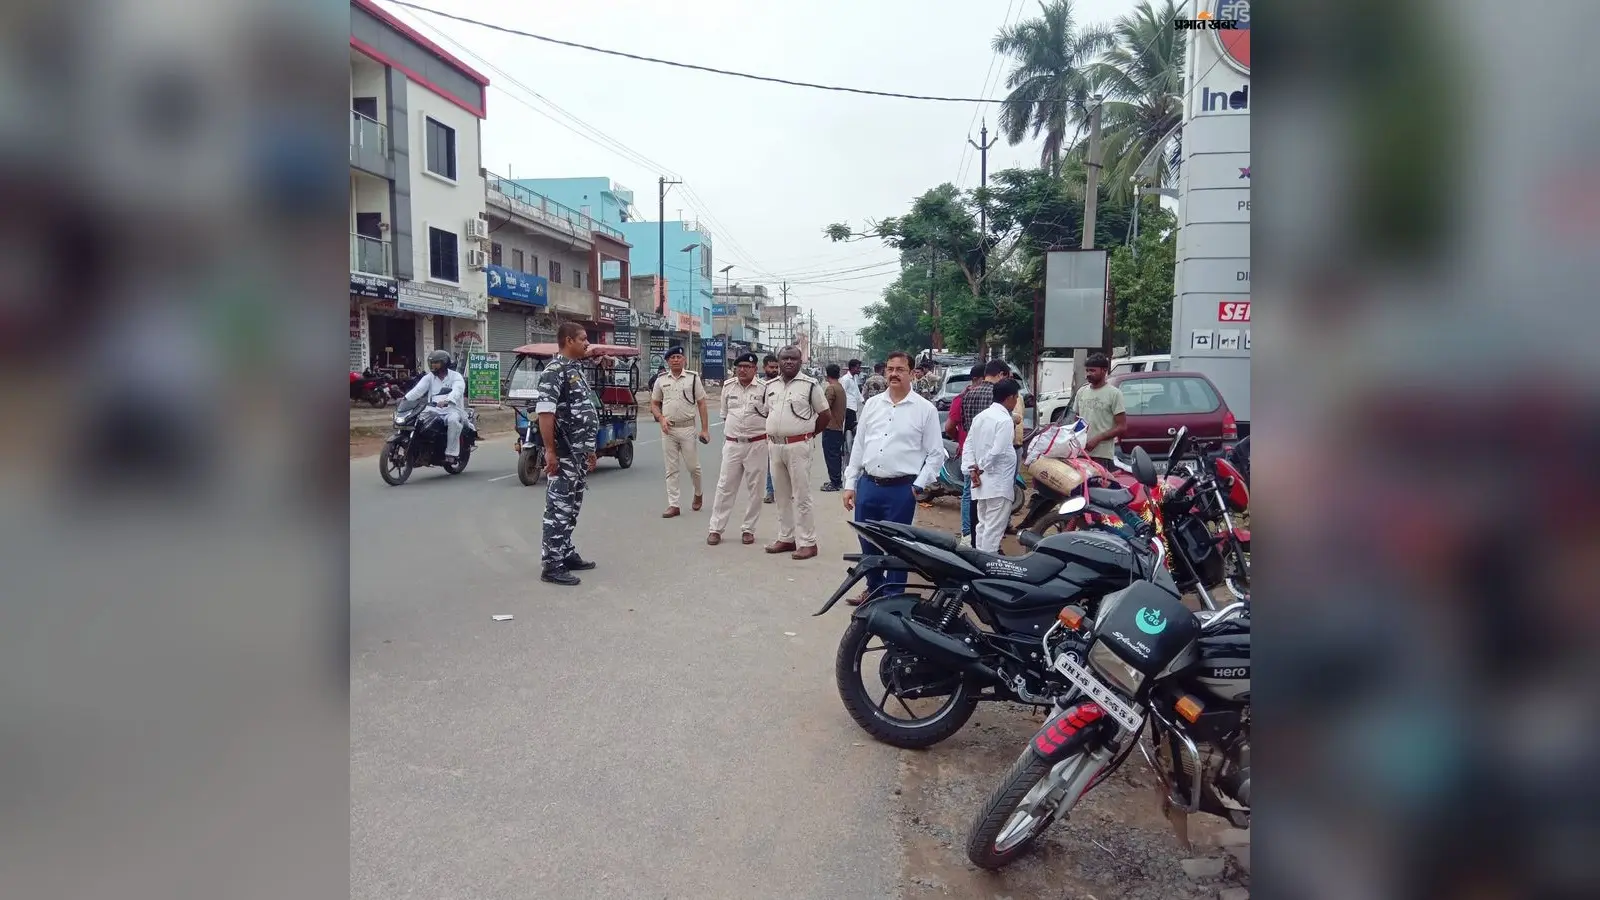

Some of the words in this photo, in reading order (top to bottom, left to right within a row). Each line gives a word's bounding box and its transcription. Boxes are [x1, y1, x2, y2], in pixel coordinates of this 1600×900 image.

[1202, 85, 1249, 112] Ind
[1144, 611, 1160, 625] 786
[1213, 667, 1247, 677] Hero
